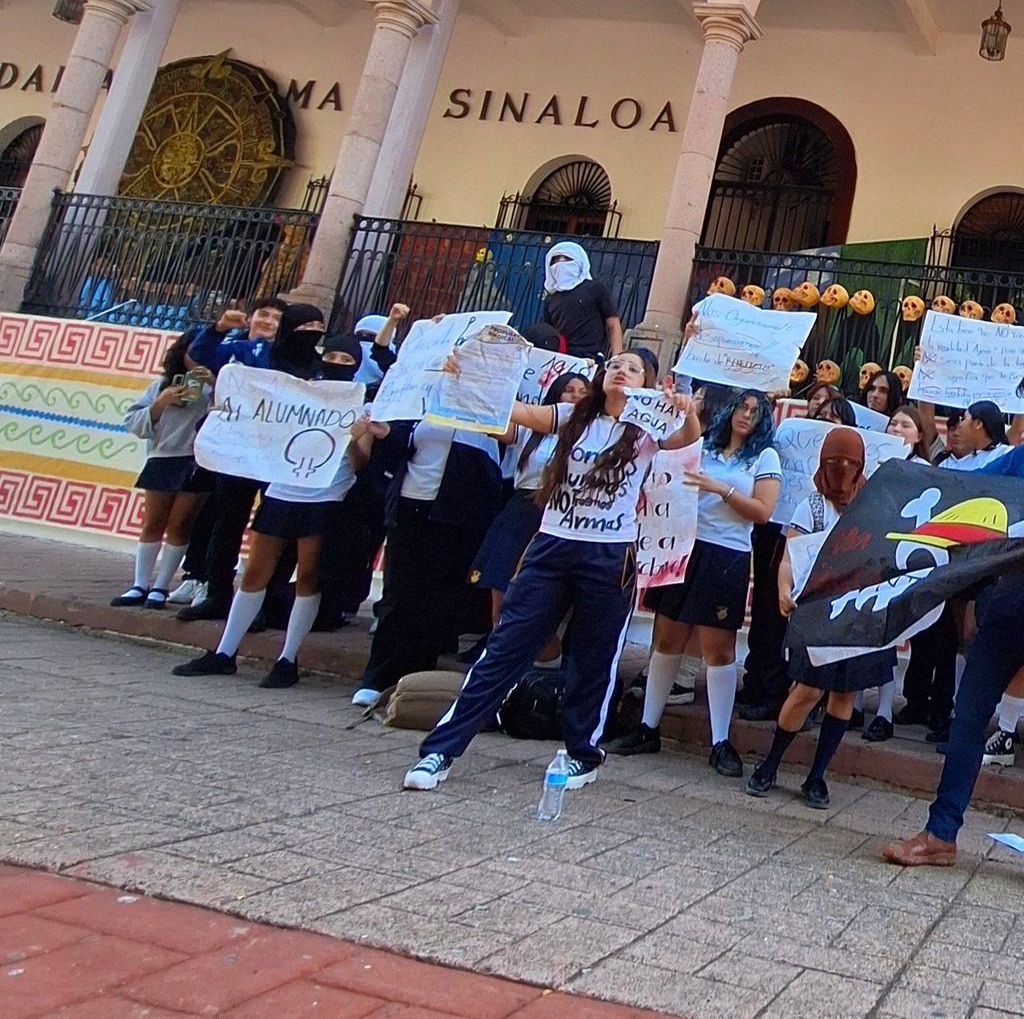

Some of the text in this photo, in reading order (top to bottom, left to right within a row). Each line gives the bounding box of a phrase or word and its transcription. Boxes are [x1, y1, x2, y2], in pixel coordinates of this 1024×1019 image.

[442, 88, 678, 133] SINALOA
[252, 398, 356, 429] ALUMNADO
[627, 408, 668, 435] AGUA
[549, 490, 571, 515] NO
[559, 506, 625, 533] Armas
